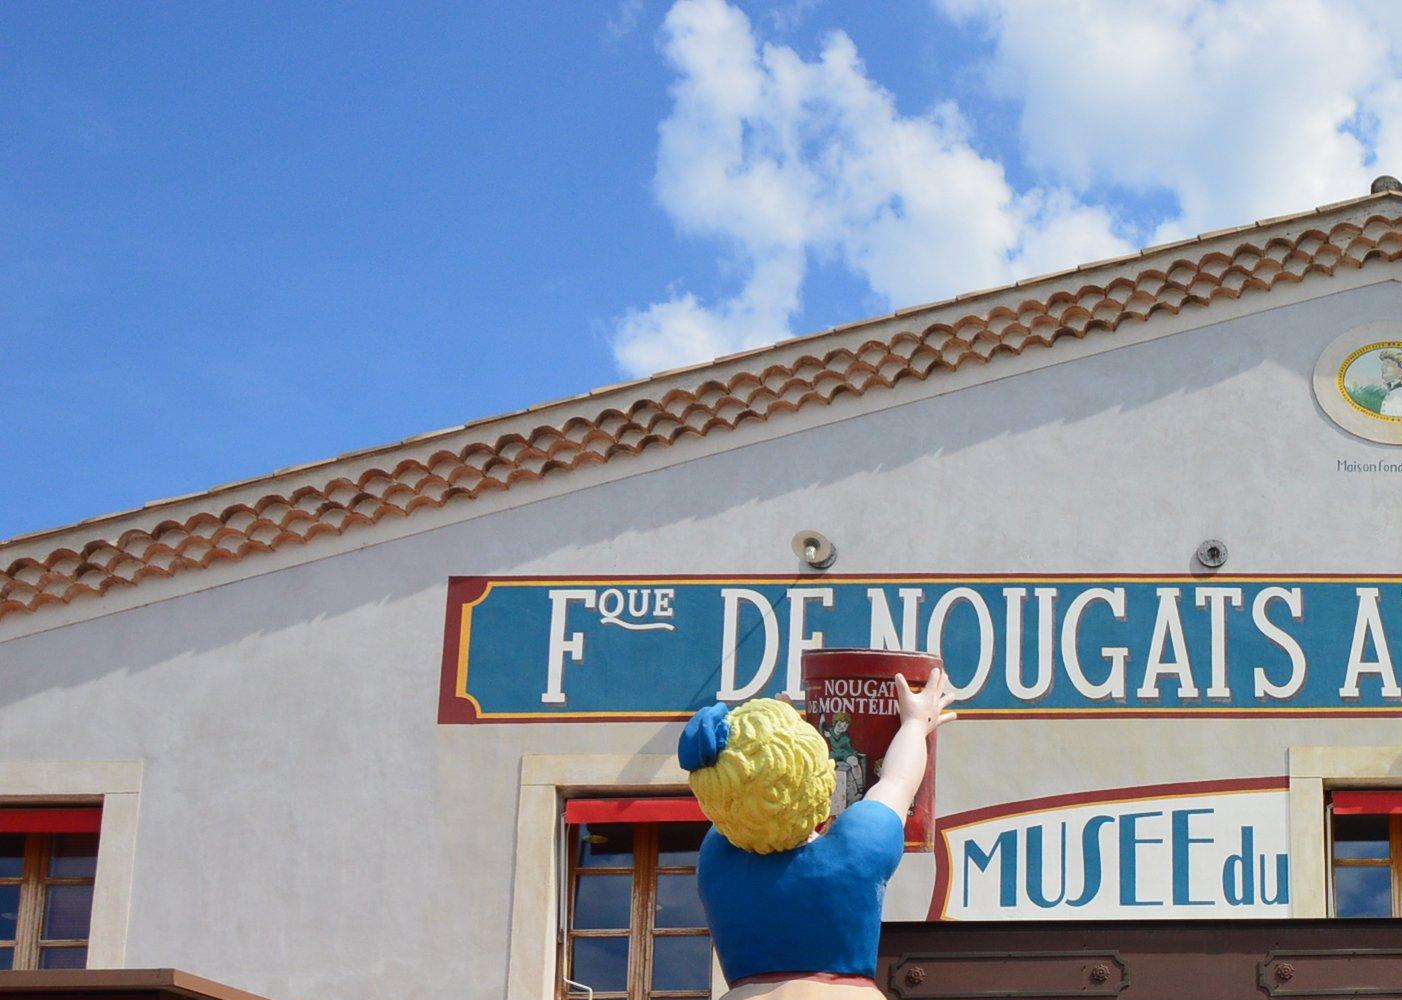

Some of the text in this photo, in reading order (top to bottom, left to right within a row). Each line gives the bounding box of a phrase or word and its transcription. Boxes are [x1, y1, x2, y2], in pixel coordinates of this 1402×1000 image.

[1337, 459, 1377, 473] Maison
[716, 586, 834, 703] DE
[867, 585, 1307, 701] NOUGATS
[824, 679, 897, 698] NOUGAT
[807, 700, 818, 714] DE
[962, 808, 1216, 909] MUSEE
[1222, 823, 1289, 907] du
